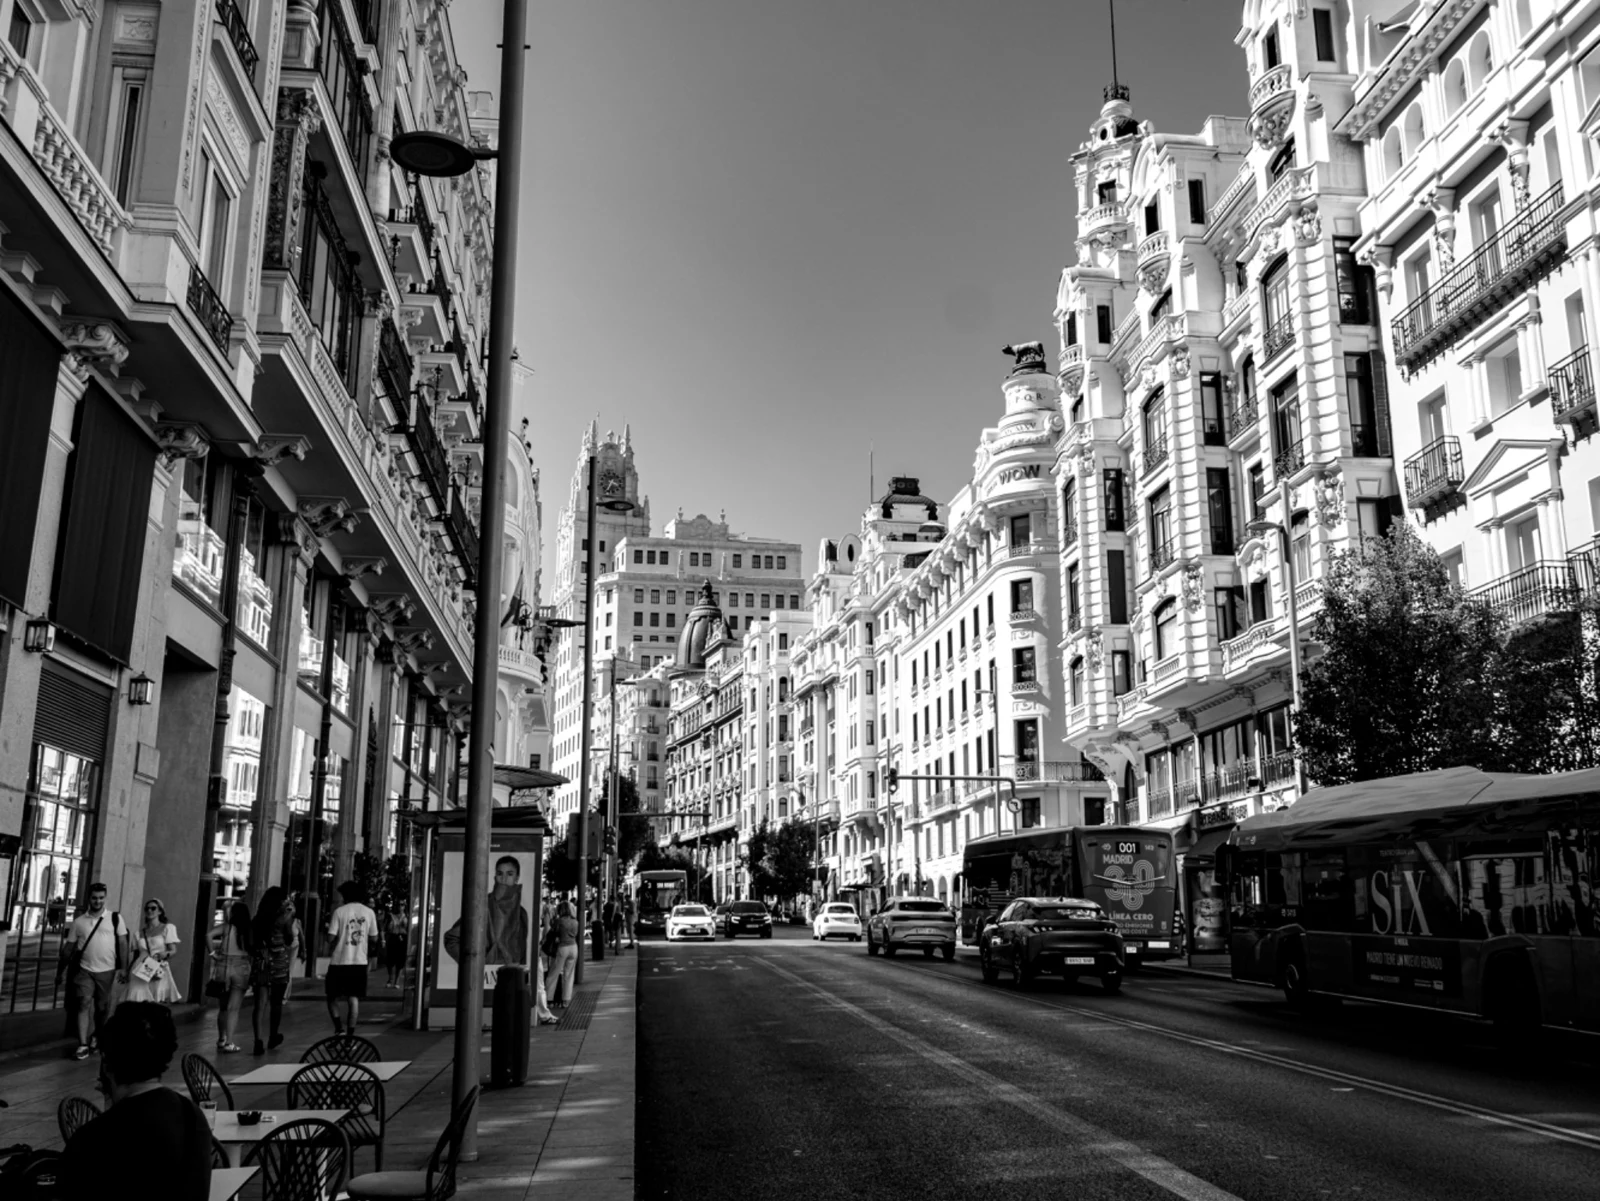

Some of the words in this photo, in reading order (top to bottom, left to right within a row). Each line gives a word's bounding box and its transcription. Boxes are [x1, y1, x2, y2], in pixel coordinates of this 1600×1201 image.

[1001, 465, 1040, 485] WOW
[1118, 842, 1136, 854] 001
[1102, 854, 1134, 865] MADRID
[1109, 911, 1131, 920] LÍNEA
[1132, 913, 1154, 921] CERO
[1366, 951, 1383, 965] MADRID
[1384, 951, 1396, 966] TIENE
[1404, 953, 1420, 968] NUEVO
[1420, 955, 1443, 970] REINADO
